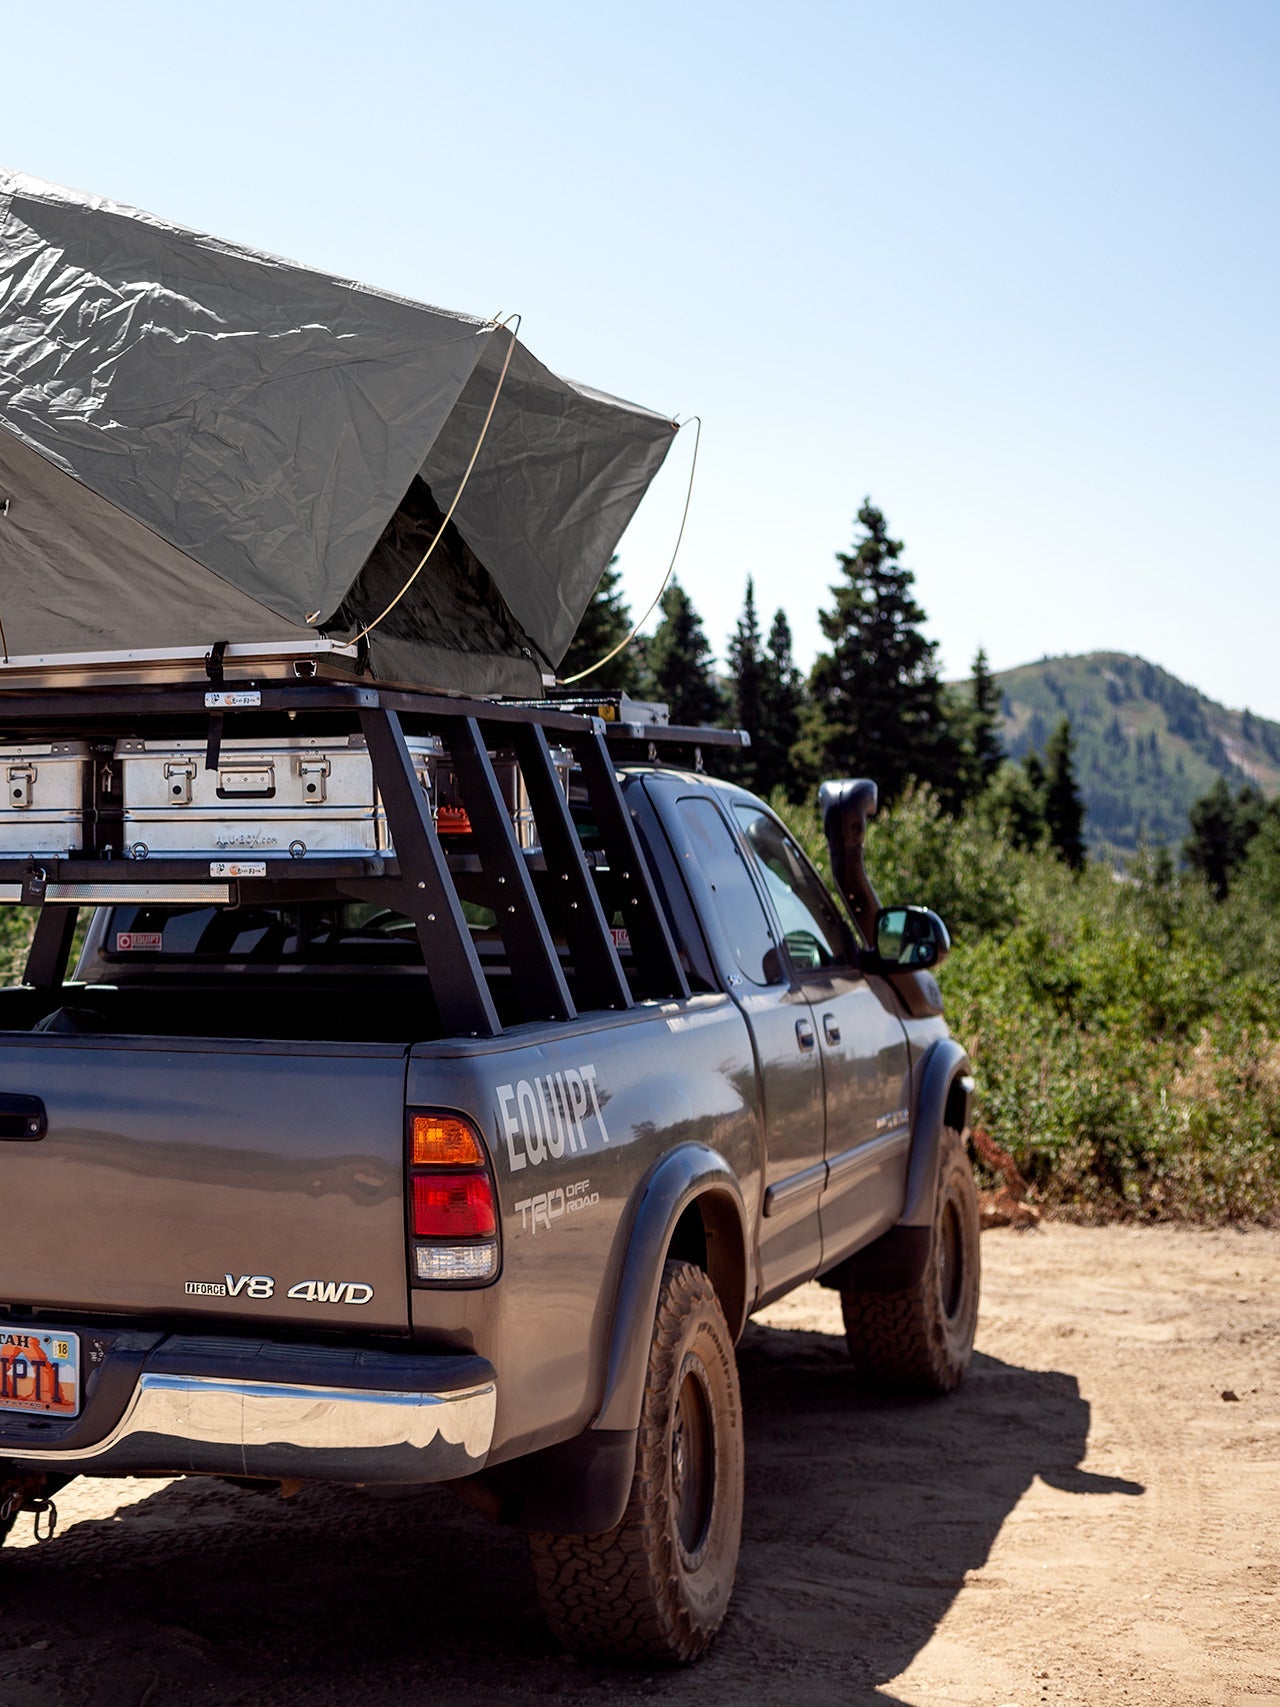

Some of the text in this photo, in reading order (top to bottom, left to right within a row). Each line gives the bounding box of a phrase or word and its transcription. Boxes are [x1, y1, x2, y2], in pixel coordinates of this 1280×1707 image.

[496, 1064, 610, 1172] EQUIPT
[566, 1179, 590, 1197] OFF
[515, 1187, 565, 1235] TRD
[566, 1192, 600, 1214] ROAD
[224, 1273, 275, 1299] V8
[287, 1279, 374, 1305] 4WD
[57, 1343, 68, 1355] 18
